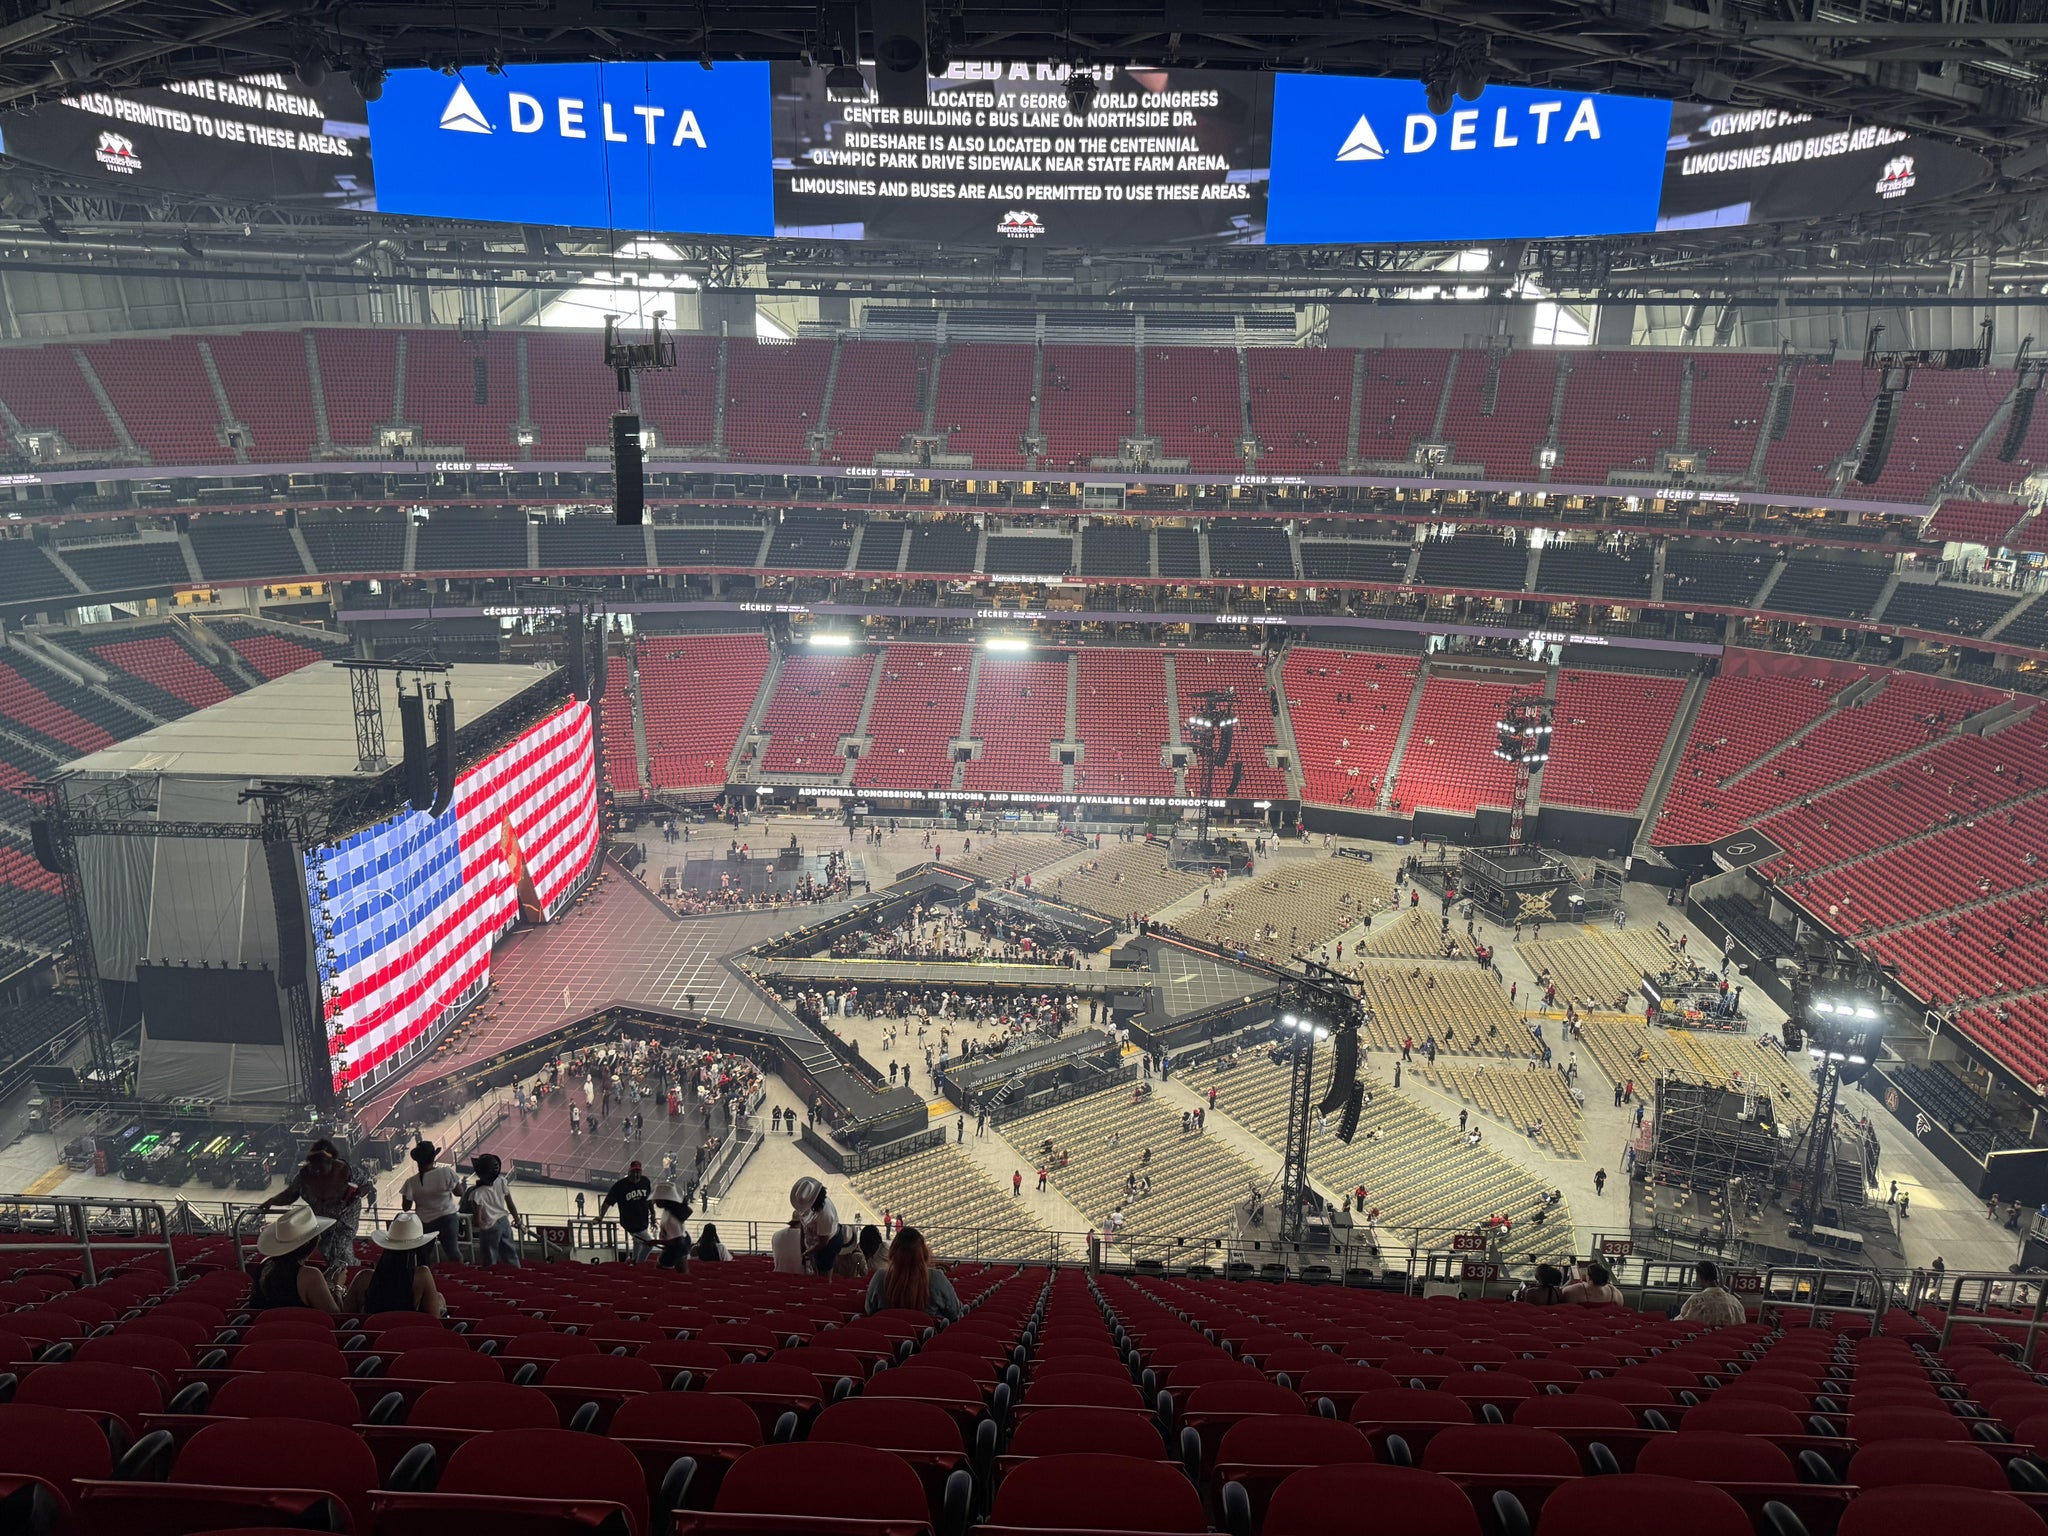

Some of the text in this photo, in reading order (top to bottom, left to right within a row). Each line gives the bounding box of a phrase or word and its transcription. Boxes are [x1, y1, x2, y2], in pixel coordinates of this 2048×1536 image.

[1009, 62, 1029, 80] A
[219, 83, 262, 108] FARM
[266, 92, 324, 119] ARENA.
[931, 92, 994, 107] LOCATED
[998, 93, 1017, 108] AT
[1020, 92, 1069, 109] GEORG
[1141, 91, 1219, 108] CONGRESS
[81, 93, 113, 117] ALSO
[116, 100, 191, 133] PERMITTED
[193, 114, 213, 138] TO
[216, 119, 245, 142] USE
[246, 123, 296, 150] THESE
[299, 132, 353, 157] AREAS.
[508, 91, 707, 148] DELTA
[844, 107, 1197, 128] CENTER BUILDING C BUS LANE ON NORTHSIDE DR.
[1403, 97, 1601, 154] DELTA
[1710, 109, 1777, 137] OLYMPIC
[845, 132, 1199, 153] RIDESHARE IS ALSO LOCATED ON THE CENTENNIAL
[1682, 147, 1770, 175] LIMOUSINES
[1771, 142, 1801, 164] AND
[1805, 131, 1849, 159] BUSES
[1848, 126, 1877, 151] ARE
[812, 150, 1230, 171] OLYMPIC PARK DRIVE SIDEWALK NEAR STATE FARM ARENA.
[791, 177, 1250, 200] LIMOUSINES AND BUSES ARE ALSO PERMITTED TO USE THESE AREAS.
[997, 224, 1045, 234] Mercedes-Benz
[992, 574, 1036, 583] Mercedes-Benz
[1037, 575, 1062, 583] Stadium
[798, 787, 855, 797] ADDITIONAL
[857, 788, 926, 800] CONCESSIONS,
[928, 791, 987, 801] RESTROOMS,
[989, 793, 1009, 801] AND
[1011, 794, 1077, 803] MERCHANDISE
[1079, 796, 1130, 805] AVAILABLE
[1133, 797, 1146, 805] ON
[1149, 797, 1166, 806] 100
[1457, 1238, 1482, 1249] 339
[1605, 1243, 1630, 1254] 338
[1467, 1265, 1494, 1278] 339
